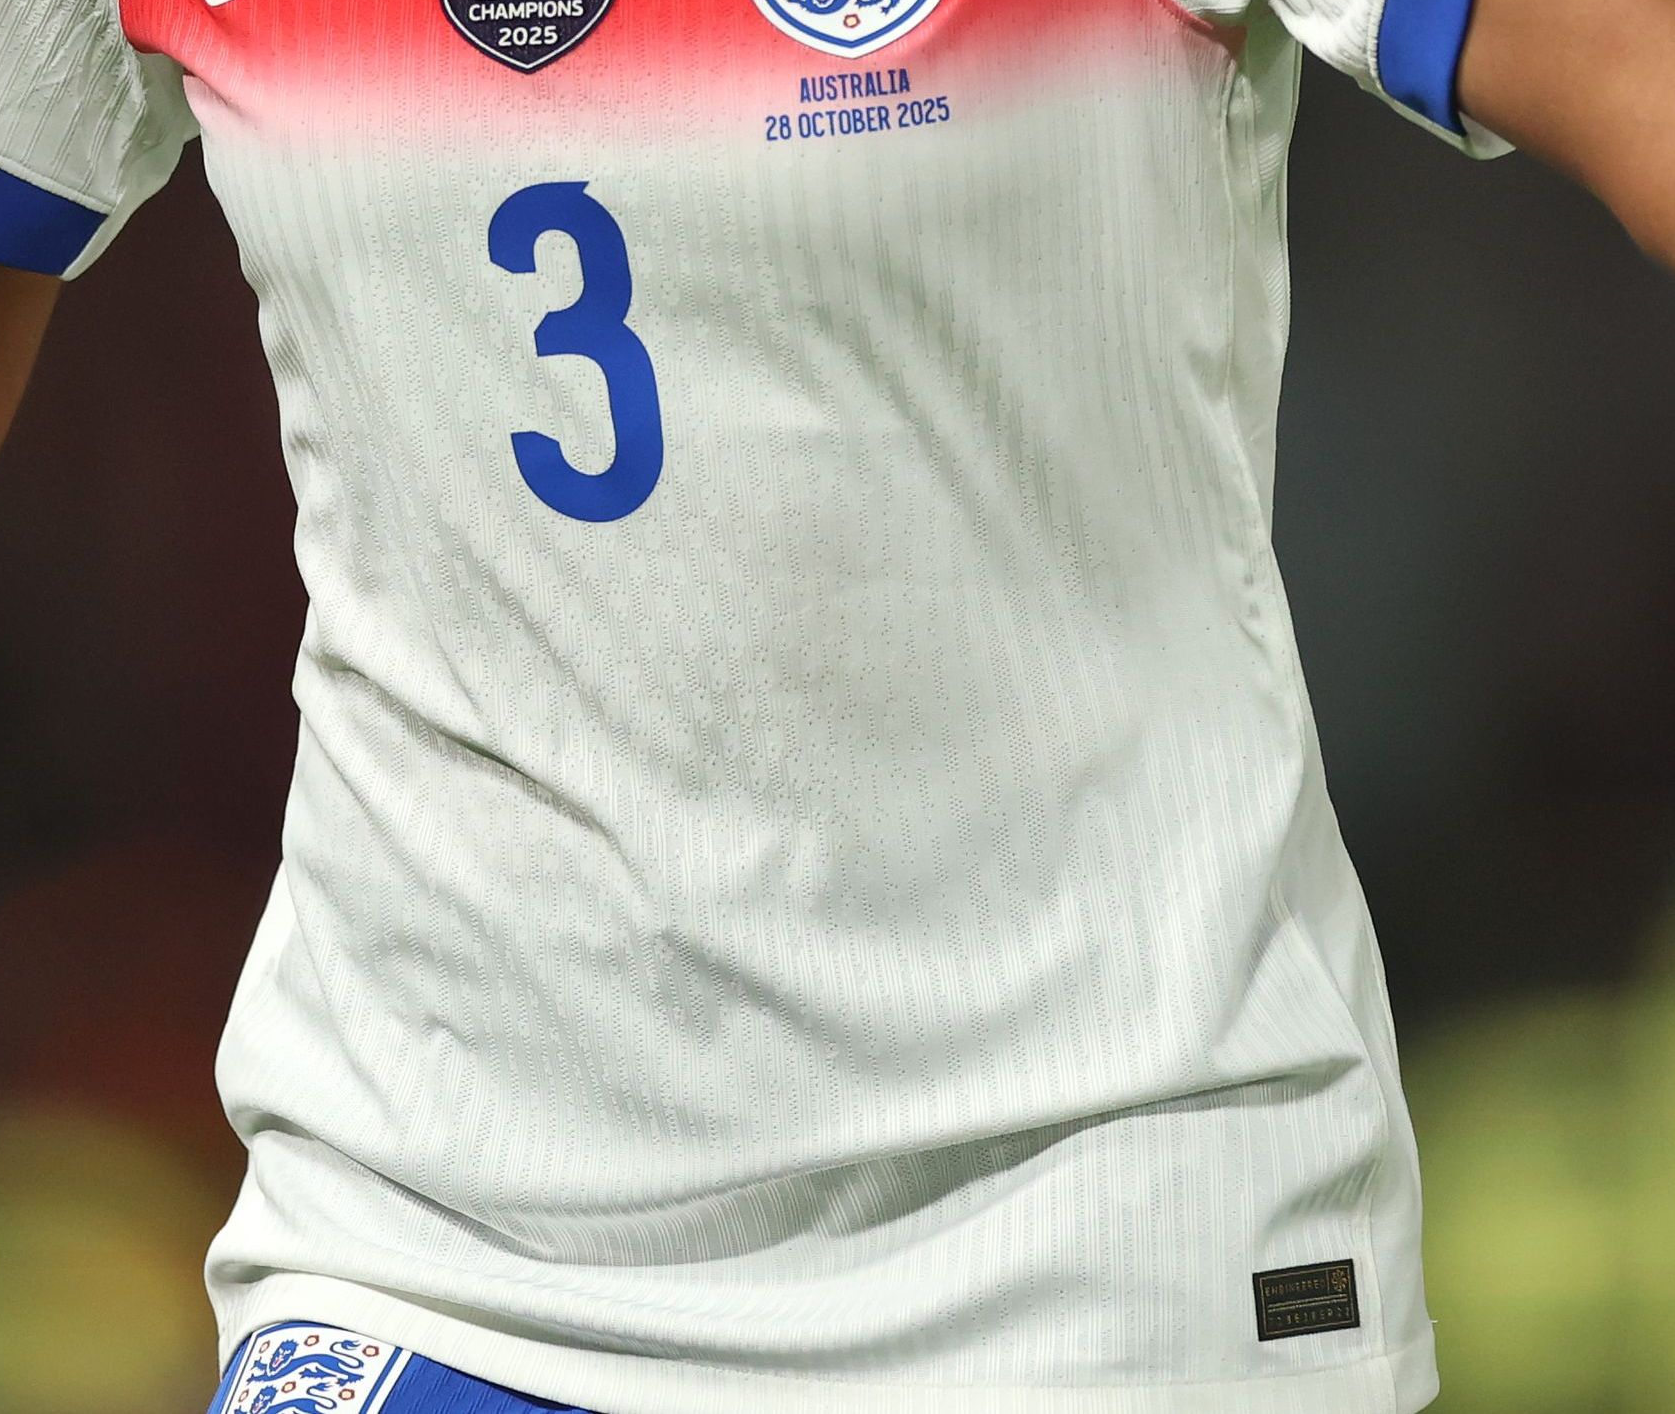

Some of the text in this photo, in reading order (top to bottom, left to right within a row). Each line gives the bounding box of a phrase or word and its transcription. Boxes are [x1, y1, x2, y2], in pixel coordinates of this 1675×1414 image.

[468, 0, 584, 21] CHAMPIONS
[498, 25, 559, 47] 2025
[799, 68, 910, 103] AUSTRALIA
[765, 96, 951, 142] 28 OCTOBER 2025
[488, 180, 664, 523] 3
